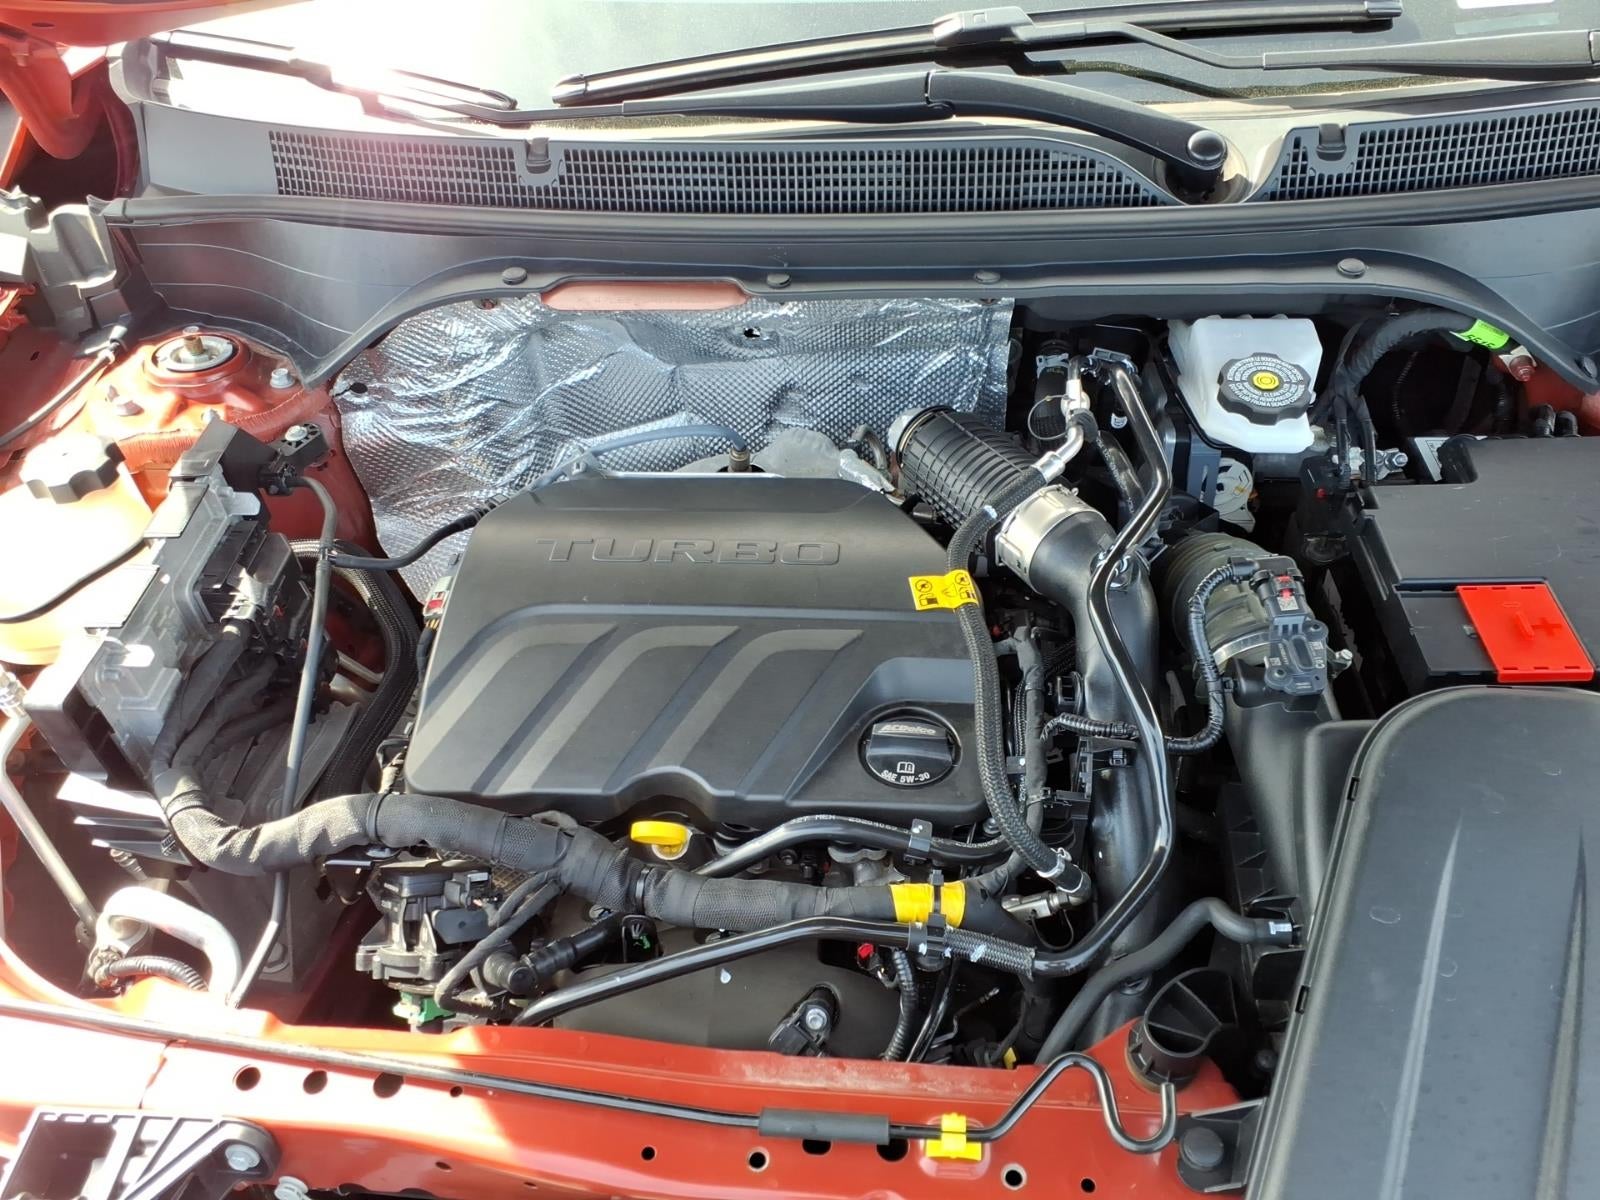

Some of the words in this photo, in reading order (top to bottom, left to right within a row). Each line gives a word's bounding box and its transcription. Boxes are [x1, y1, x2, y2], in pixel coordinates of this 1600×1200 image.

[535, 537, 842, 566] TURBO
[880, 769, 898, 782] SAE
[900, 771, 931, 784] 5W-30
